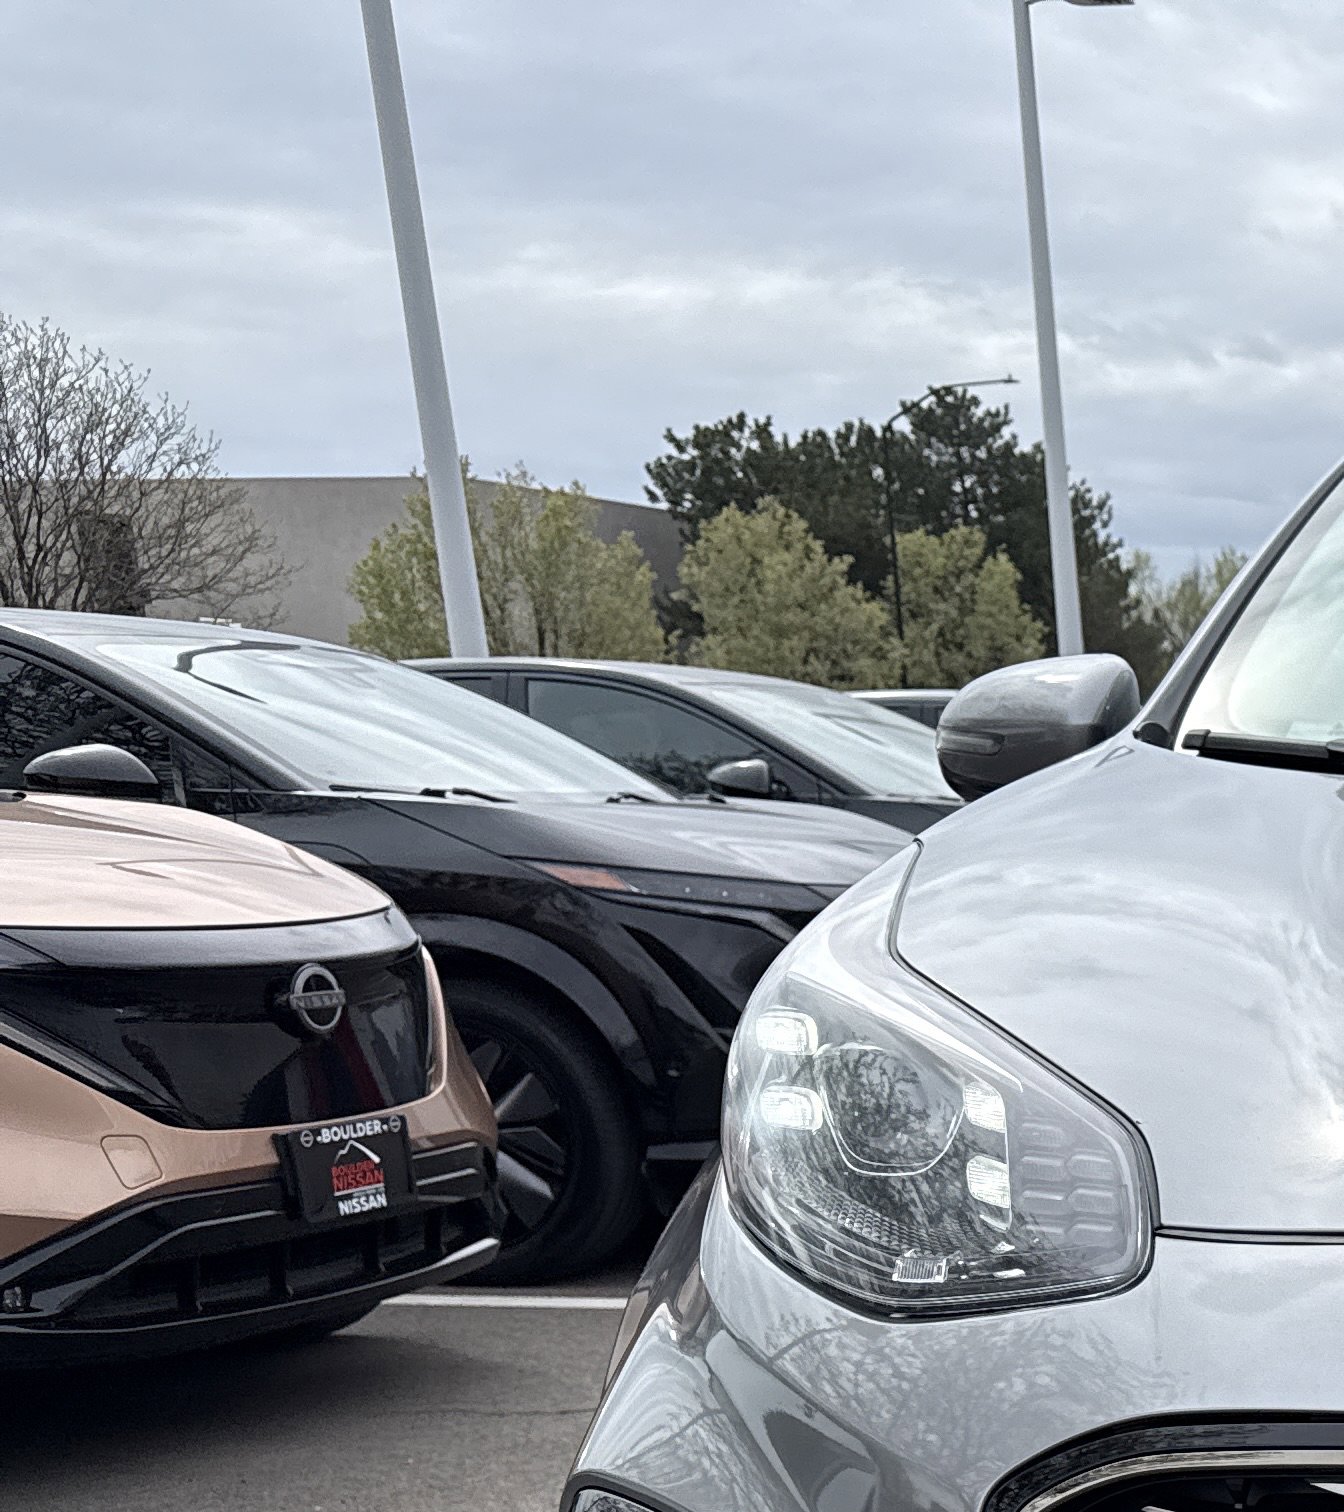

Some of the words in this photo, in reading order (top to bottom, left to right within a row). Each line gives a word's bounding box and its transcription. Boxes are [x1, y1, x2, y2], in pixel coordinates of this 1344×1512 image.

[320, 1120, 383, 1143] BOULDER
[333, 1168, 384, 1193] NISSAN
[338, 1192, 387, 1216] NISSAN
